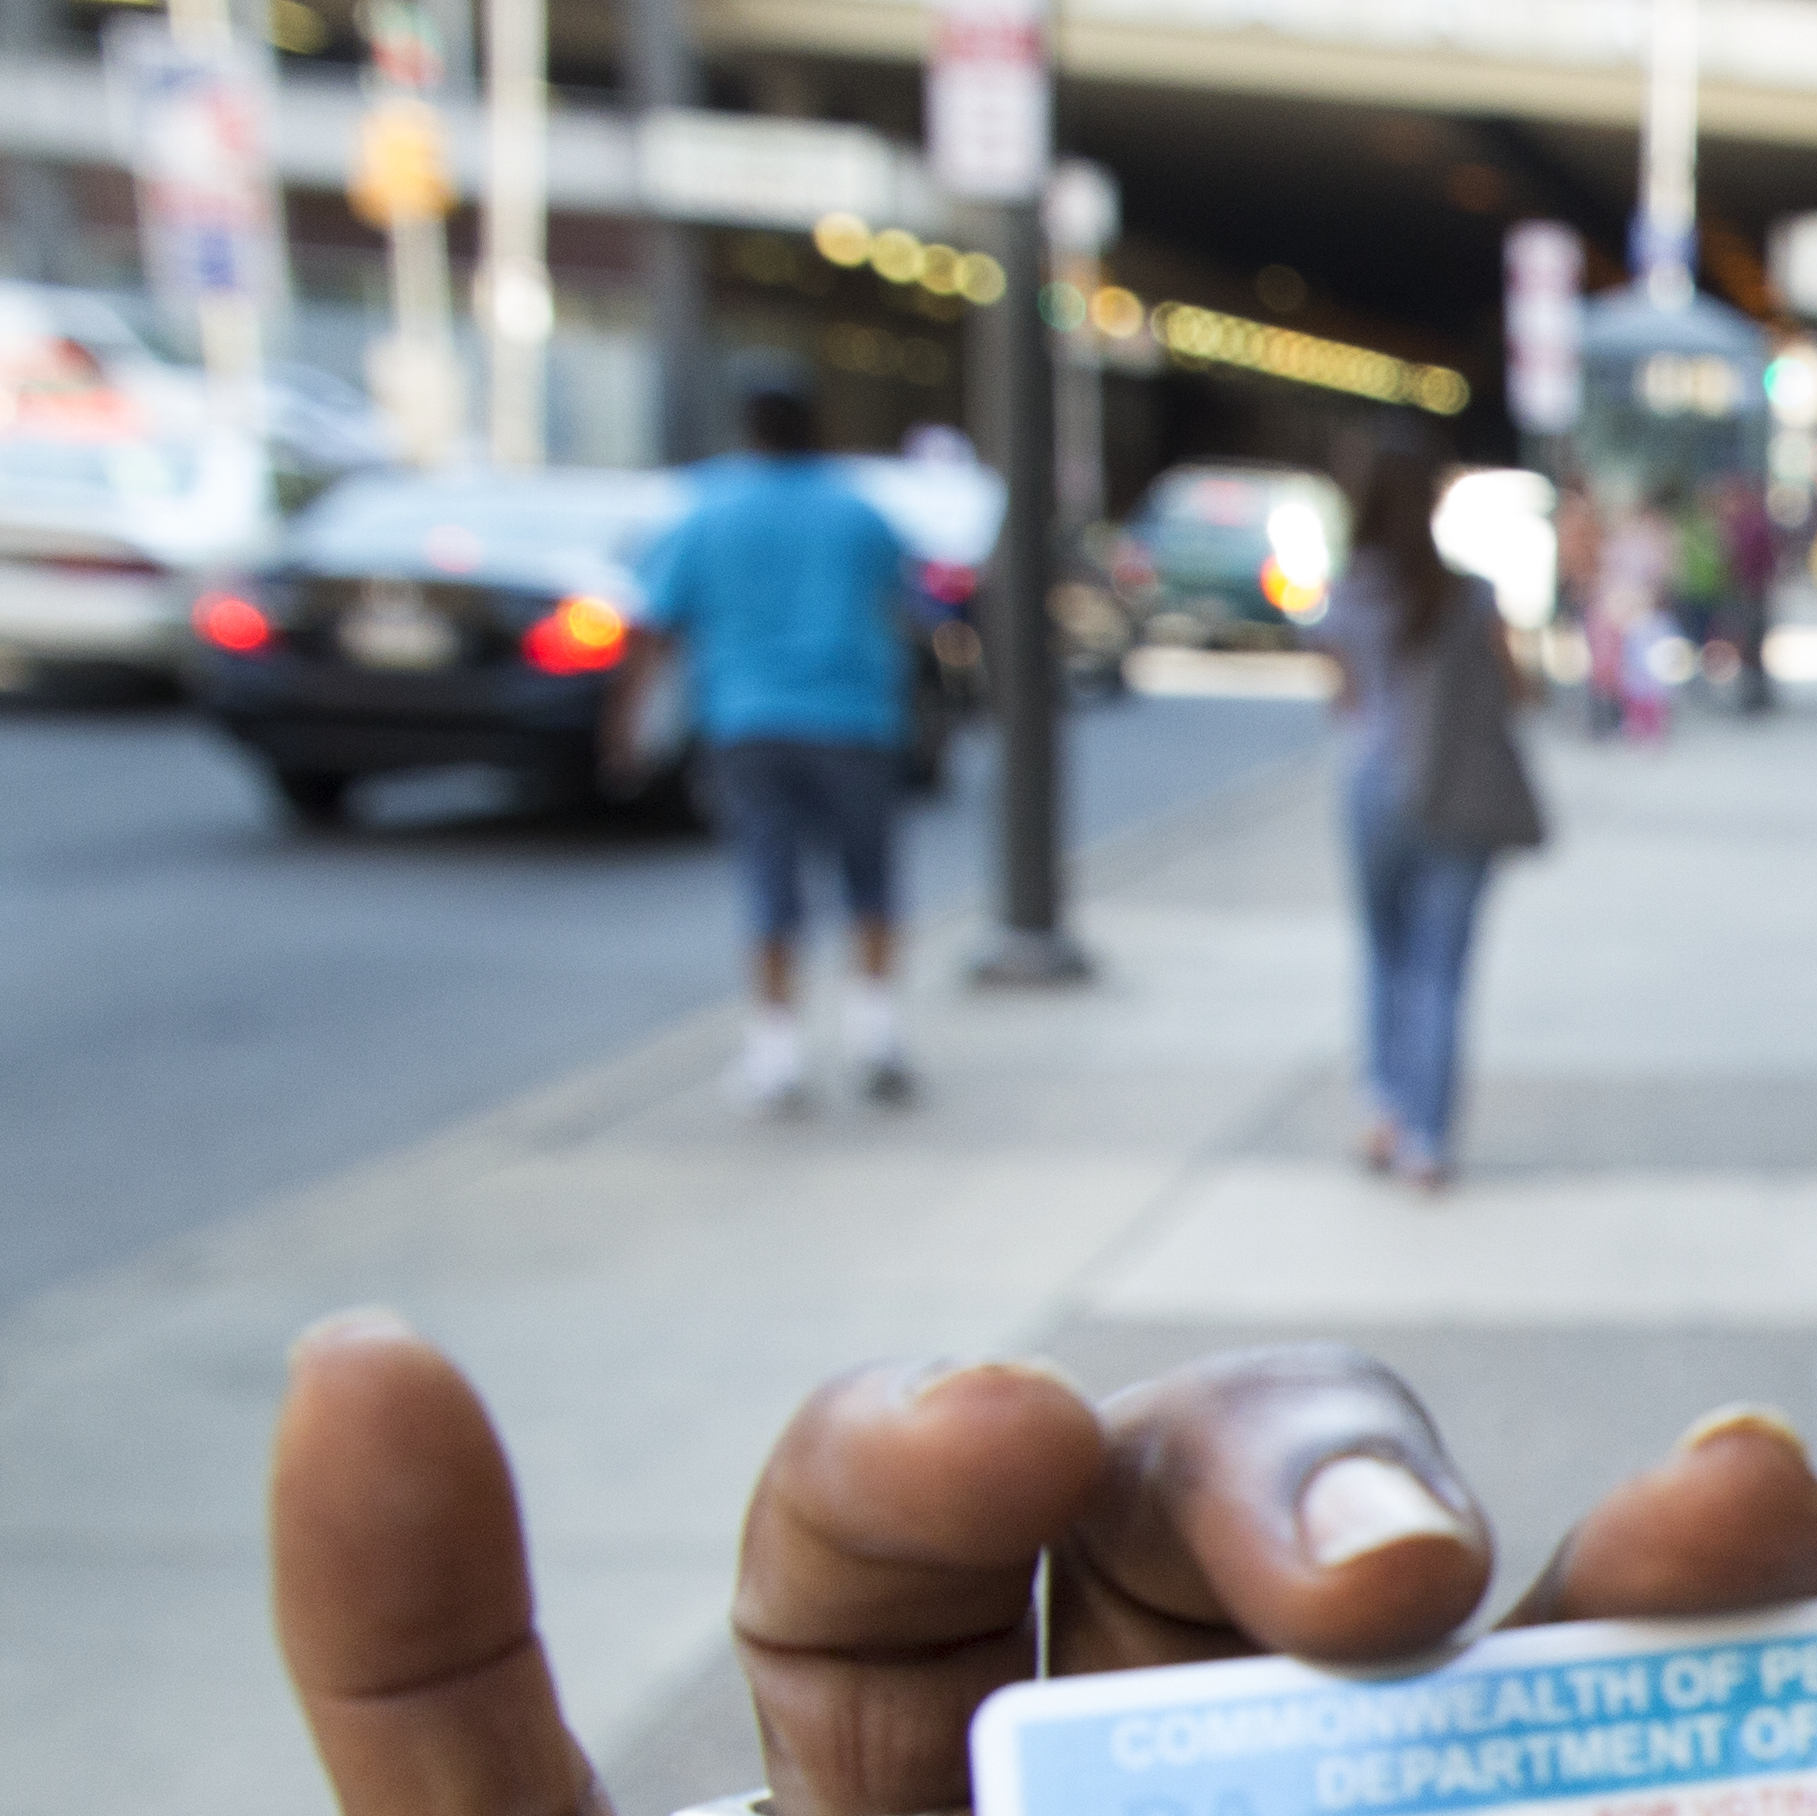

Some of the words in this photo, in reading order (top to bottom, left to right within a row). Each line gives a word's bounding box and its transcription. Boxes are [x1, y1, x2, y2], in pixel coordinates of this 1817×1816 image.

[1109, 1656, 1652, 1773] COMMONWEALTH
[1662, 1652, 1752, 1706] OF
[1313, 1715, 1731, 1812] DEPARTMENT
